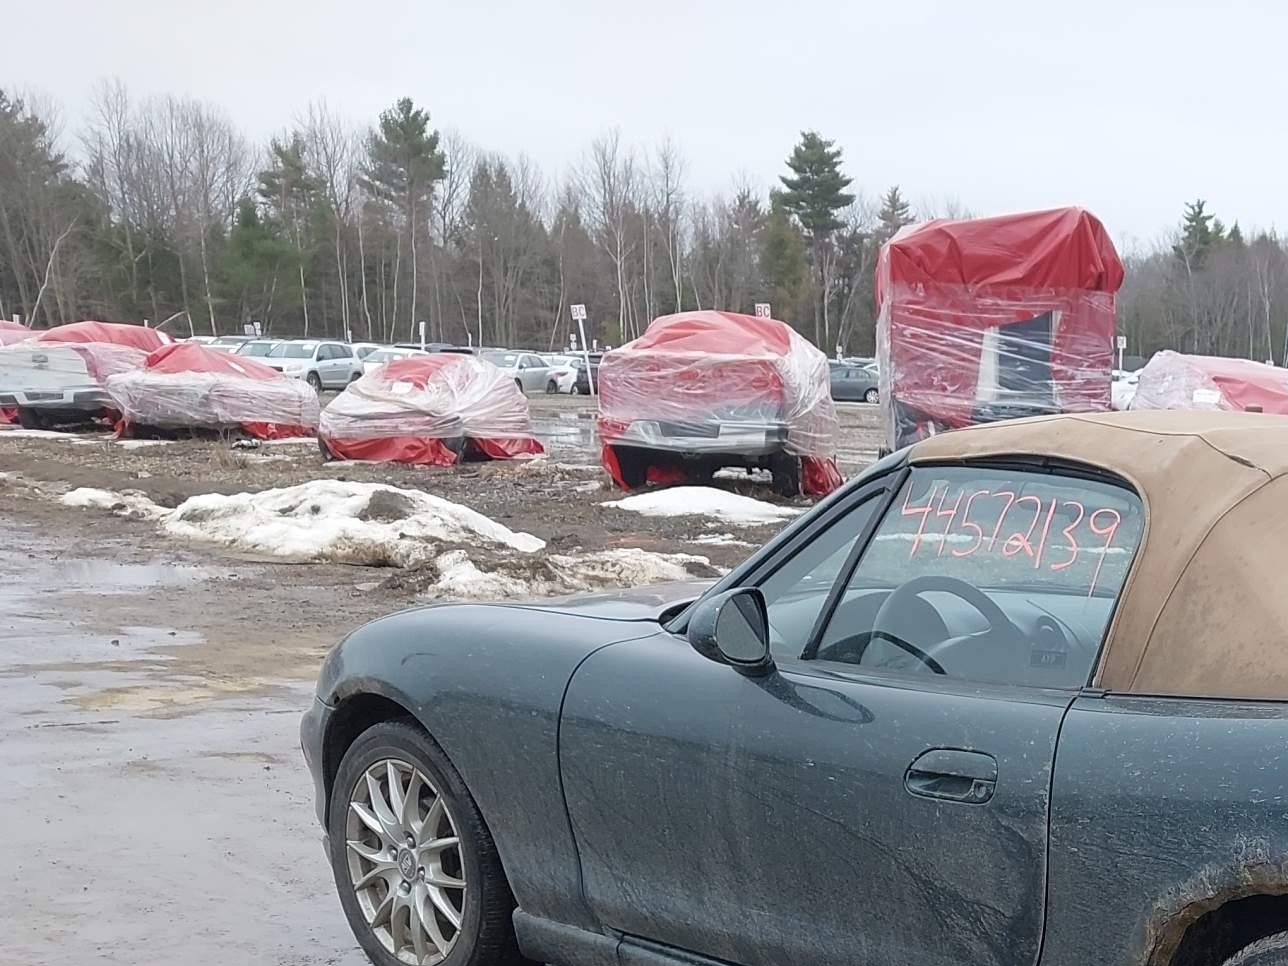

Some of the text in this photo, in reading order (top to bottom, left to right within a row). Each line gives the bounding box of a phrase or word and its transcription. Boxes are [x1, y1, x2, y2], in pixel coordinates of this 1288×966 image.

[571, 306, 586, 318] BC
[756, 305, 771, 318] BC
[901, 480, 1121, 600] 44572139
